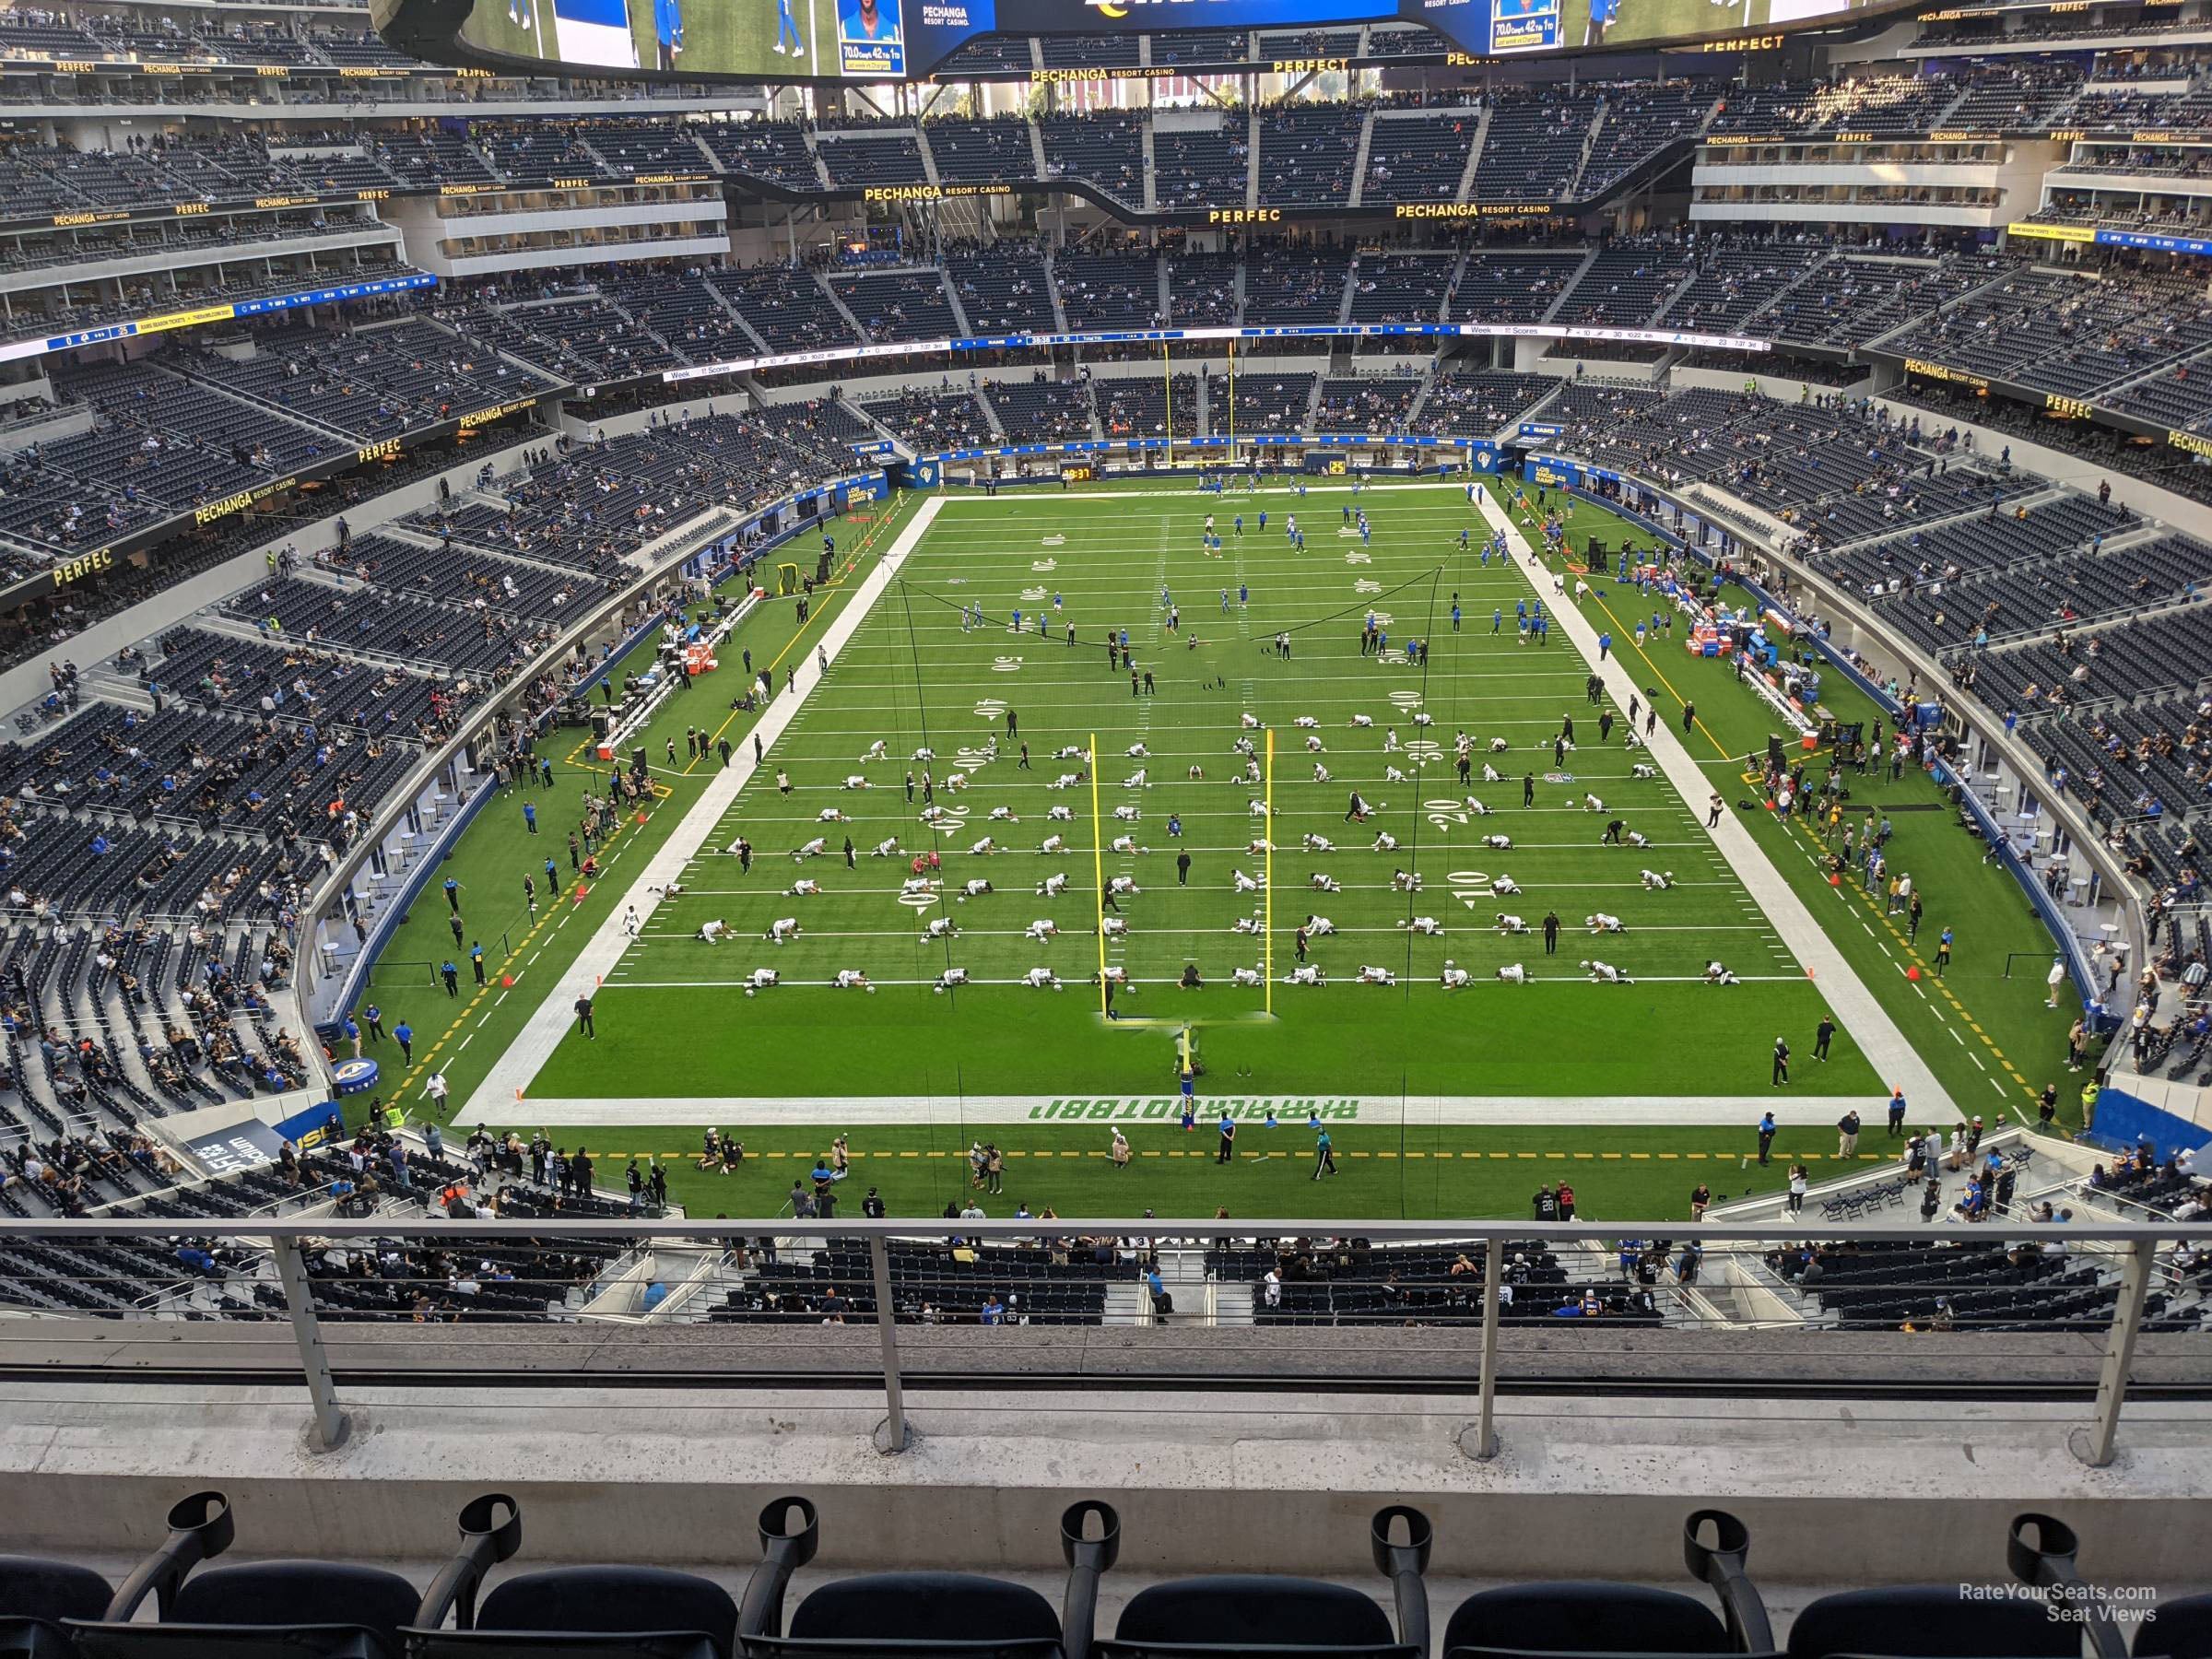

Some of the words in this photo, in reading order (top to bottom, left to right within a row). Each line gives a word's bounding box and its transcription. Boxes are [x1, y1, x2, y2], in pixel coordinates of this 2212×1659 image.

[924, 6, 966, 18] PECHANGA
[2050, 2, 2089, 13] PERFECT
[1496, 24, 1512, 35] 70.0
[1525, 20, 1535, 32] 42
[1543, 18, 1548, 30] 1
[844, 46, 859, 59] 70.0
[873, 47, 881, 59] 42
[890, 48, 894, 58] 1
[57, 63, 95, 72] PERFECT
[144, 65, 181, 74] PECHANGA
[257, 67, 288, 76] PERFECT
[340, 68, 378, 76] PECHANGA
[1274, 59, 1348, 74] PERFECT
[1031, 68, 1108, 82] PECHANGA
[1112, 68, 1143, 77] RESORT
[1145, 67, 1176, 76] CASINO
[1836, 134, 1873, 142] PERFEC
[2133, 133, 2169, 142] PECHANGA
[555, 179, 588, 188] PERFEC
[635, 175, 674, 184] PECHANGA
[359, 191, 389, 199] PERFEC
[441, 185, 477, 194] PECHANGA
[865, 186, 942, 201] PECHANGA
[256, 197, 290, 208] PECHANGA
[175, 205, 210, 214] PERFEC
[1396, 205, 1478, 218] PECHANGA
[54, 214, 96, 225] PECHANGA
[1209, 210, 1280, 223] PERFEC
[66, 336, 72, 345] 0
[671, 371, 689, 380] Week
[709, 365, 730, 374] Scores
[1904, 359, 1948, 380] PECHANGA
[1949, 371, 1967, 383] RESORT
[1969, 376, 1987, 387] CASINO
[2046, 394, 2092, 419] PERFEC
[461, 407, 503, 429] PECHANGA
[503, 403, 519, 413] RESORT
[520, 398, 536, 409] CASINO
[359, 439, 402, 463] PERFEC
[860, 444, 879, 453] RAMS
[1331, 463, 1344, 474] 25
[1535, 477, 1556, 485] RAMS
[1537, 471, 1566, 483] ANGELES
[195, 492, 253, 525] PECHANGA
[253, 486, 275, 500] RESORT
[276, 477, 295, 491] CASINO
[848, 496, 866, 505] RAMS
[53, 549, 112, 587] PERFEC
[992, 656, 1024, 671] 50
[1388, 691, 1423, 708] 40
[973, 699, 1007, 715] 40
[1405, 741, 1443, 761] 30
[953, 747, 991, 768] 30
[1423, 800, 1468, 824] 20
[1447, 872, 1497, 899] 10
[1543, 1199, 1554, 1211] 28
[1561, 1194, 1574, 1205] 23
[353, 1201, 363, 1211] 28
[869, 1206, 874, 1215] 4
[1138, 1237, 1145, 1246] 3
[1646, 1264, 1657, 1274] 28
[1512, 1274, 1528, 1283] 34
[387, 1290, 398, 1301] 75
[1644, 1300, 1652, 1311] 4
[992, 1316, 999, 1325] 9
